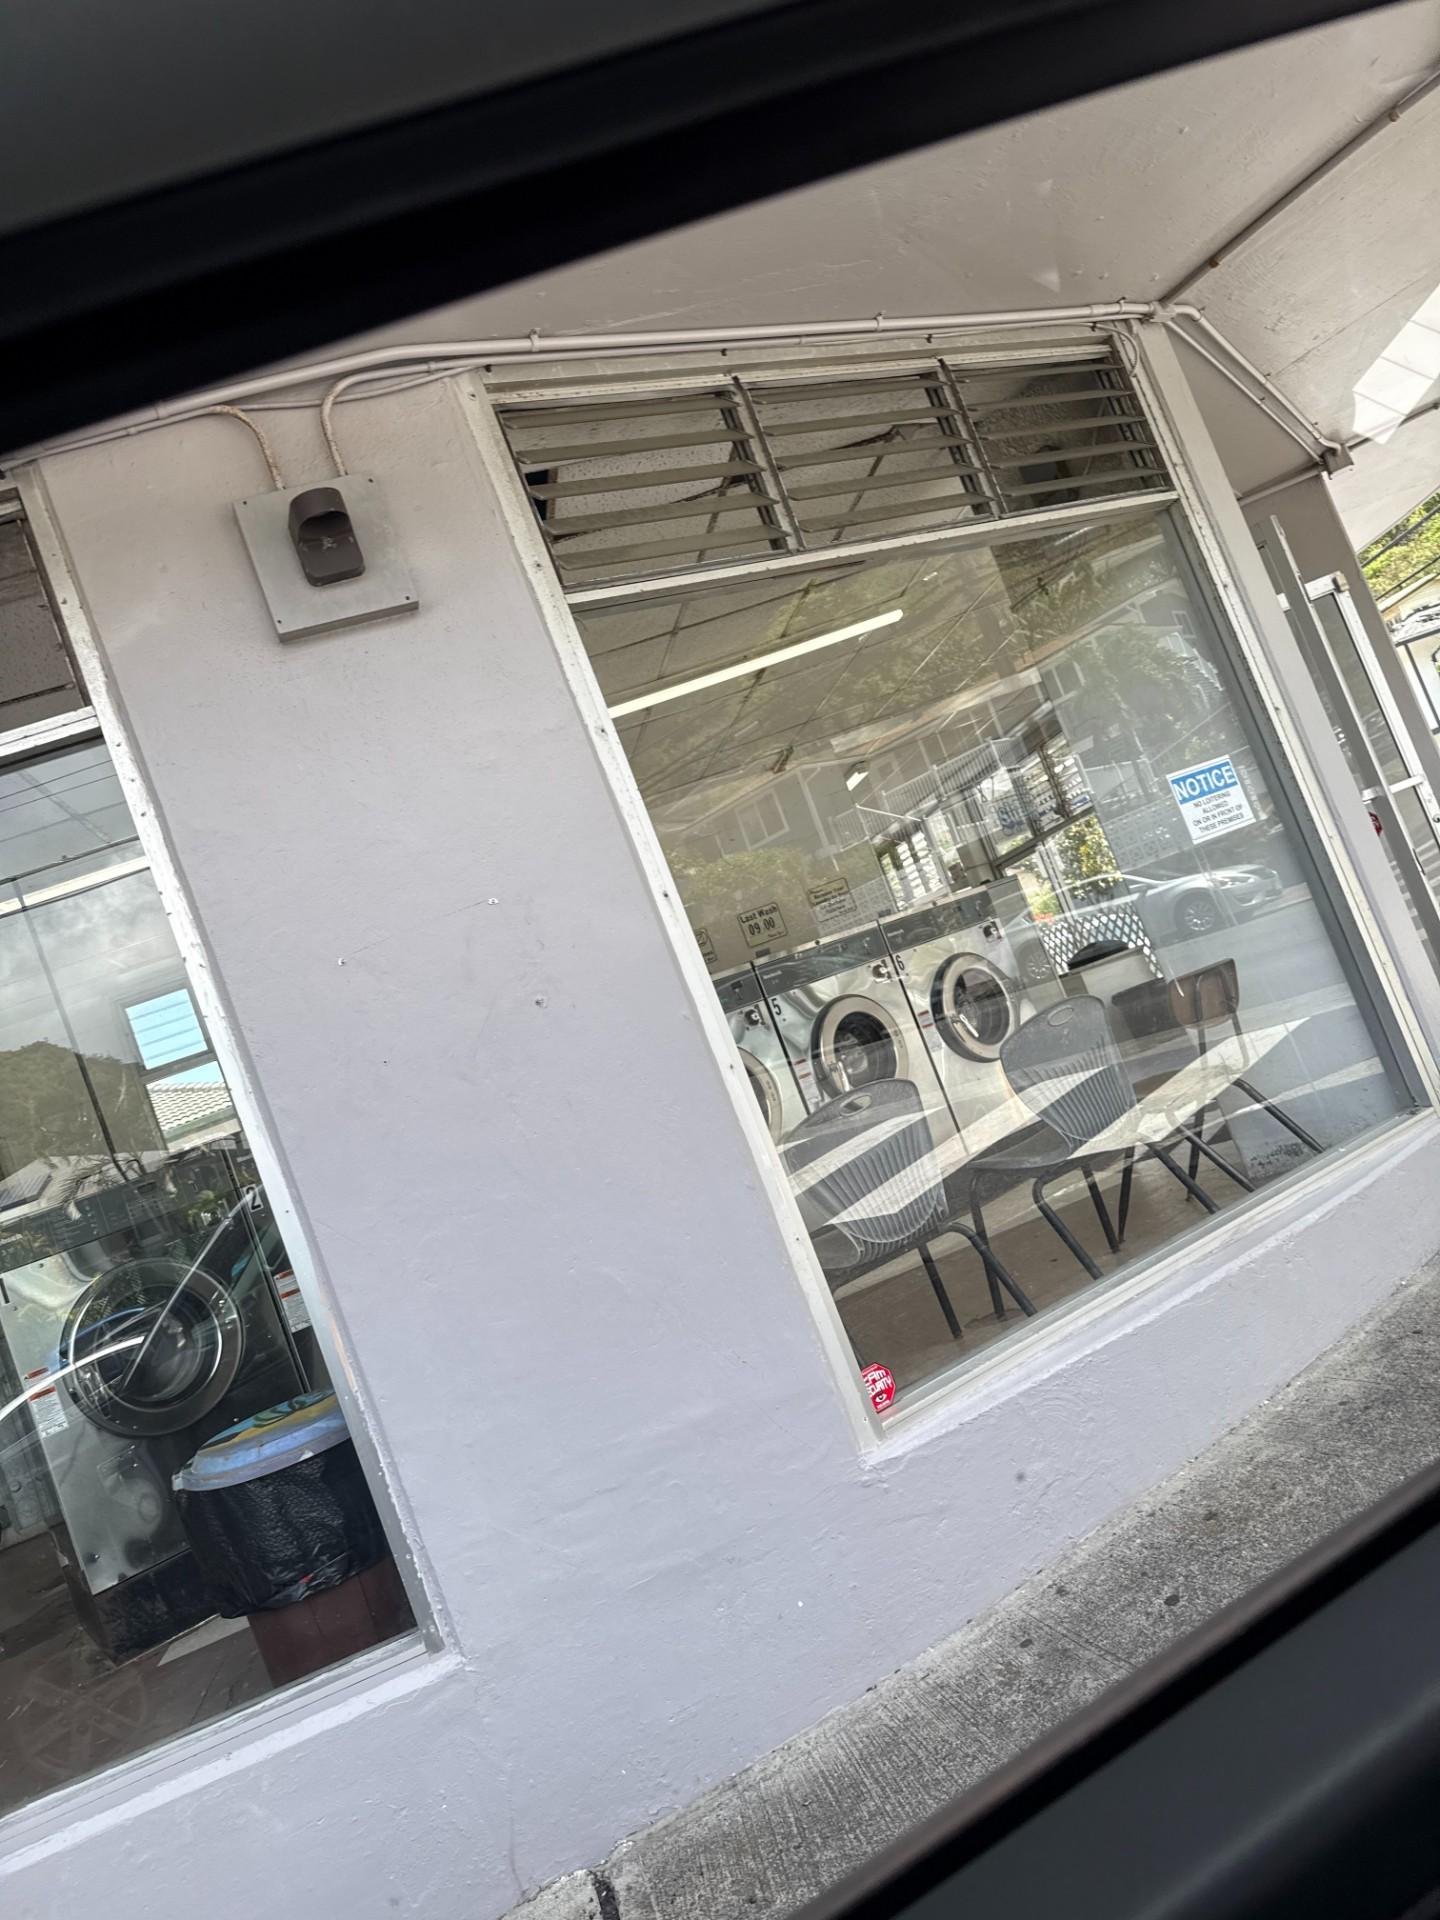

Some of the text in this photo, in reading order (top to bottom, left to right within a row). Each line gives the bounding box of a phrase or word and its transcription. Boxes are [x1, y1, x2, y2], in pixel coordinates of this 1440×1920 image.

[1173, 766, 1236, 800] NOTICE
[1192, 818, 1202, 826] ON
[1217, 806, 1236, 818] FRONT
[1199, 813, 1245, 833] THESE PREMISES
[740, 911, 758, 924] Last
[895, 955, 905, 971] 6
[772, 998, 782, 1015] 5
[246, 1187, 261, 1209] 2
